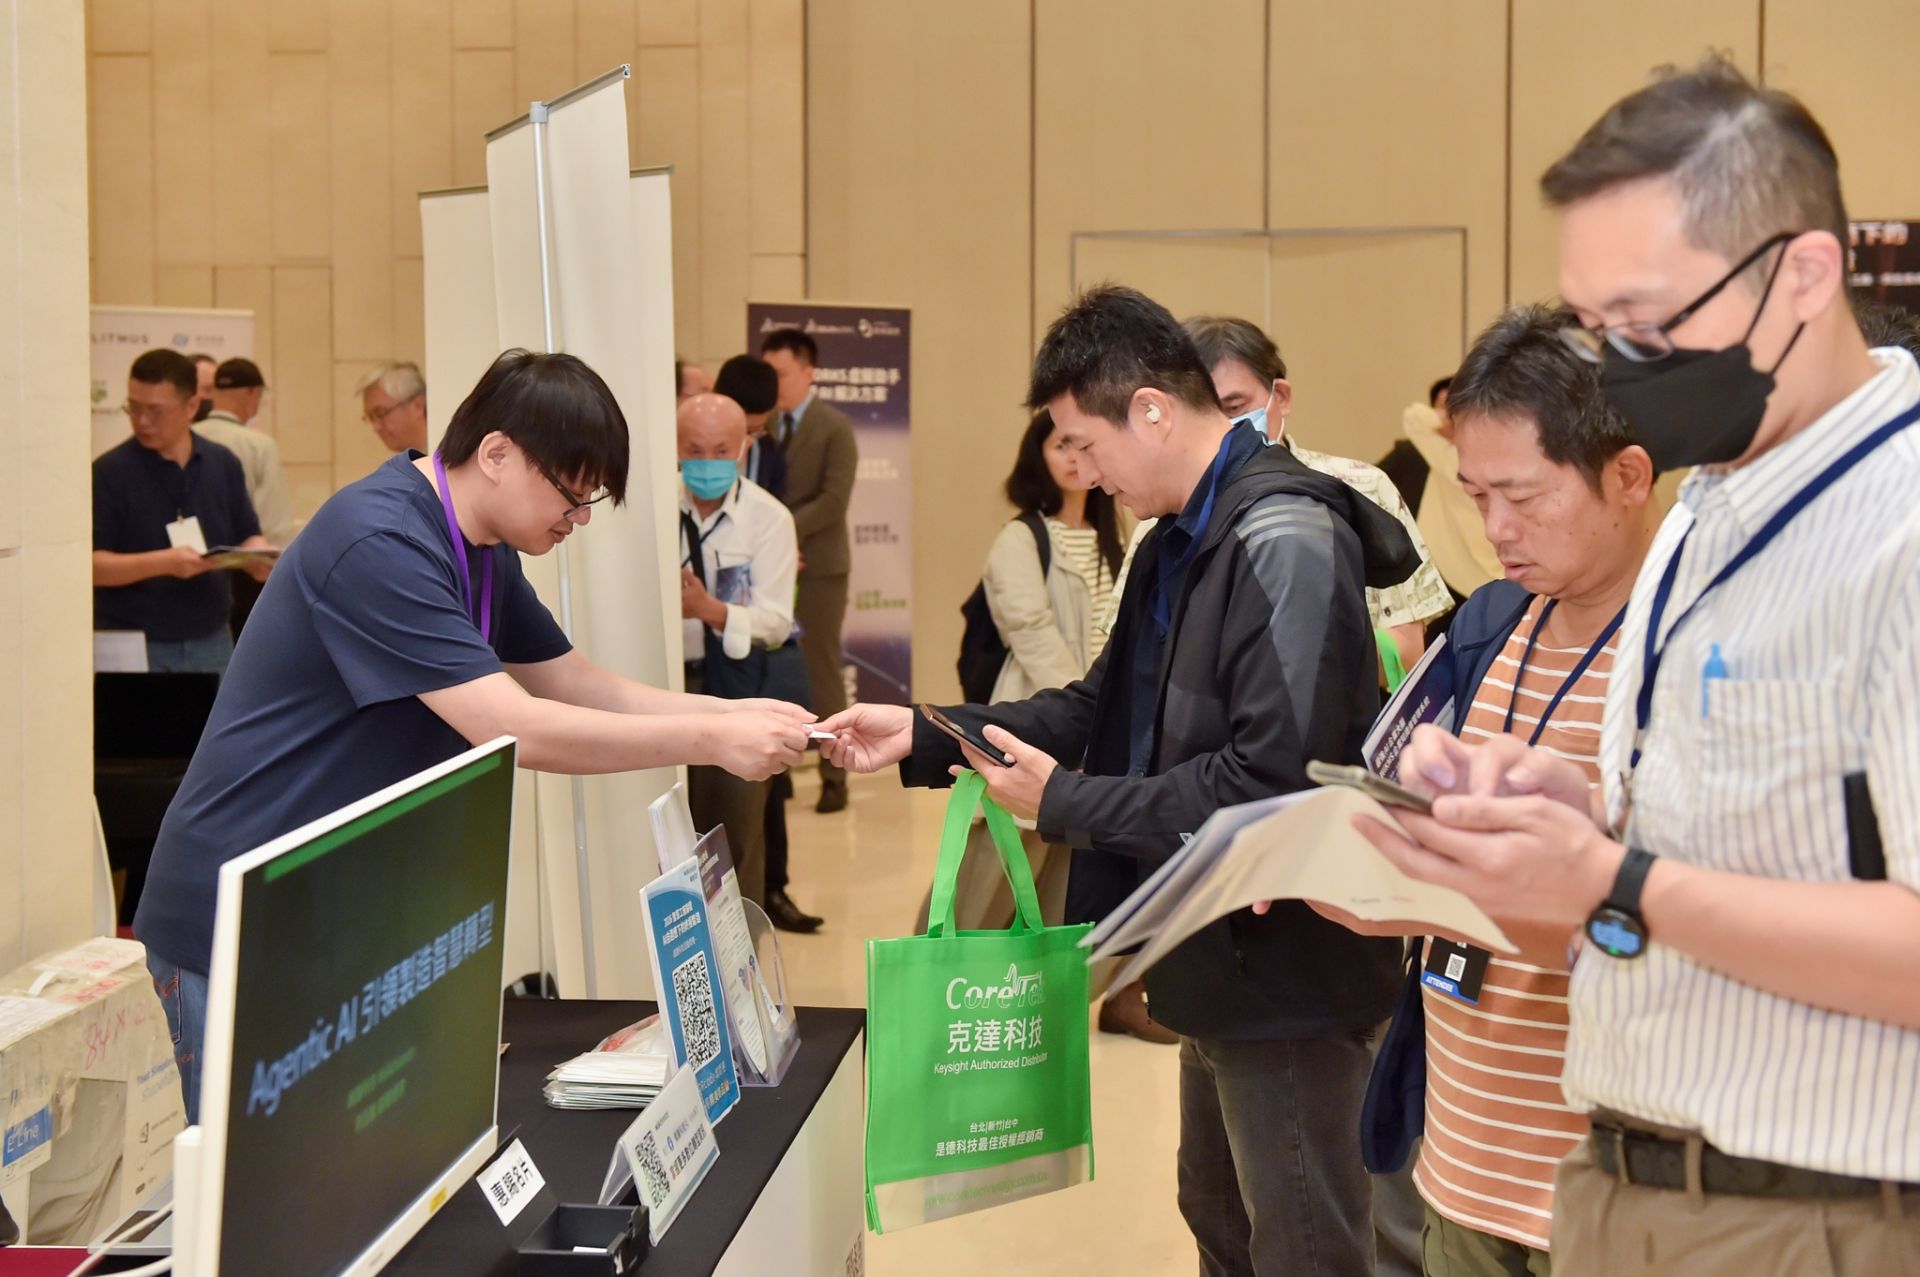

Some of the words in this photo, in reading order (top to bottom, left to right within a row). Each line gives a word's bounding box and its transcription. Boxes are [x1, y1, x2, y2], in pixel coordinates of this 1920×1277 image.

[1425, 975, 1454, 993] ATTENDEE
[947, 1014, 1043, 1054] 克達科技
[247, 1017, 334, 1118] Agentic
[334, 995, 359, 1051] AI
[934, 1059, 969, 1076] Keysight
[969, 1056, 1020, 1071] Authorized
[935, 1128, 1045, 1157] 是德科技最佳授權經銷商
[490, 1157, 534, 1208] 惠賜名片
